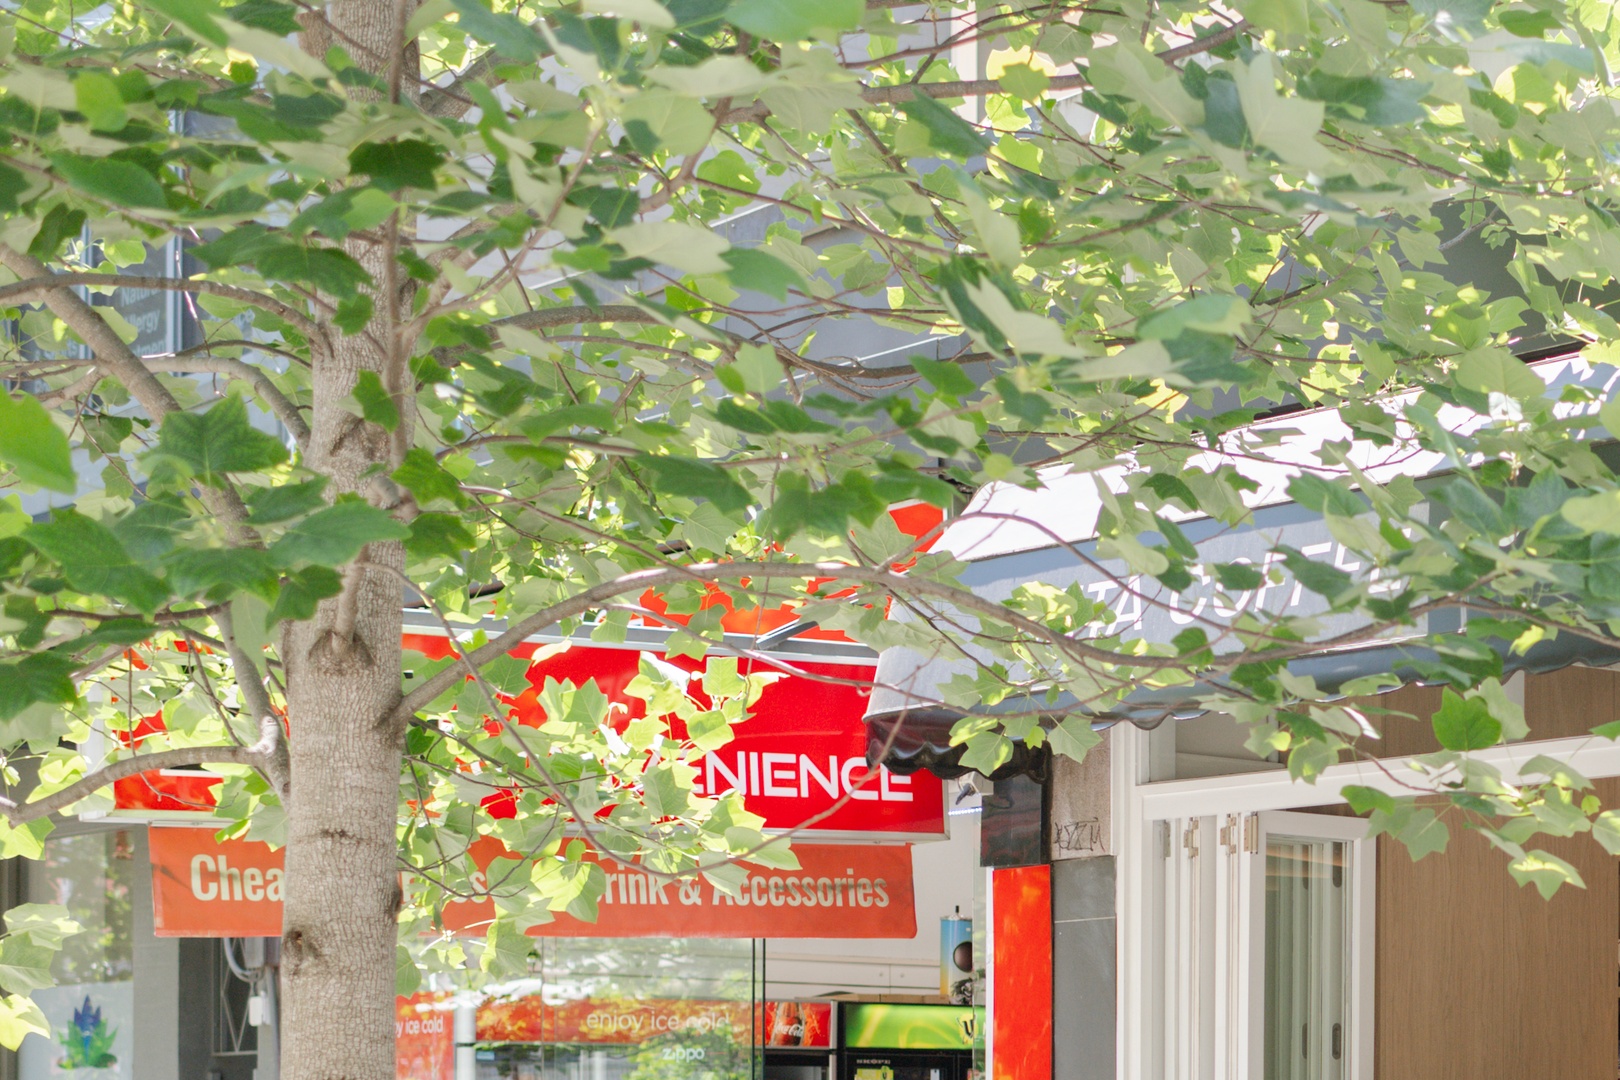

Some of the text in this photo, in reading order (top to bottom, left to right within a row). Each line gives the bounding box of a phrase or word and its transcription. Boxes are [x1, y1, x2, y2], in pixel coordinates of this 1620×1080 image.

[597, 863, 669, 905] rink
[712, 868, 890, 908] Accessories
[586, 1009, 644, 1032] enjoy
[649, 1010, 679, 1031] ice
